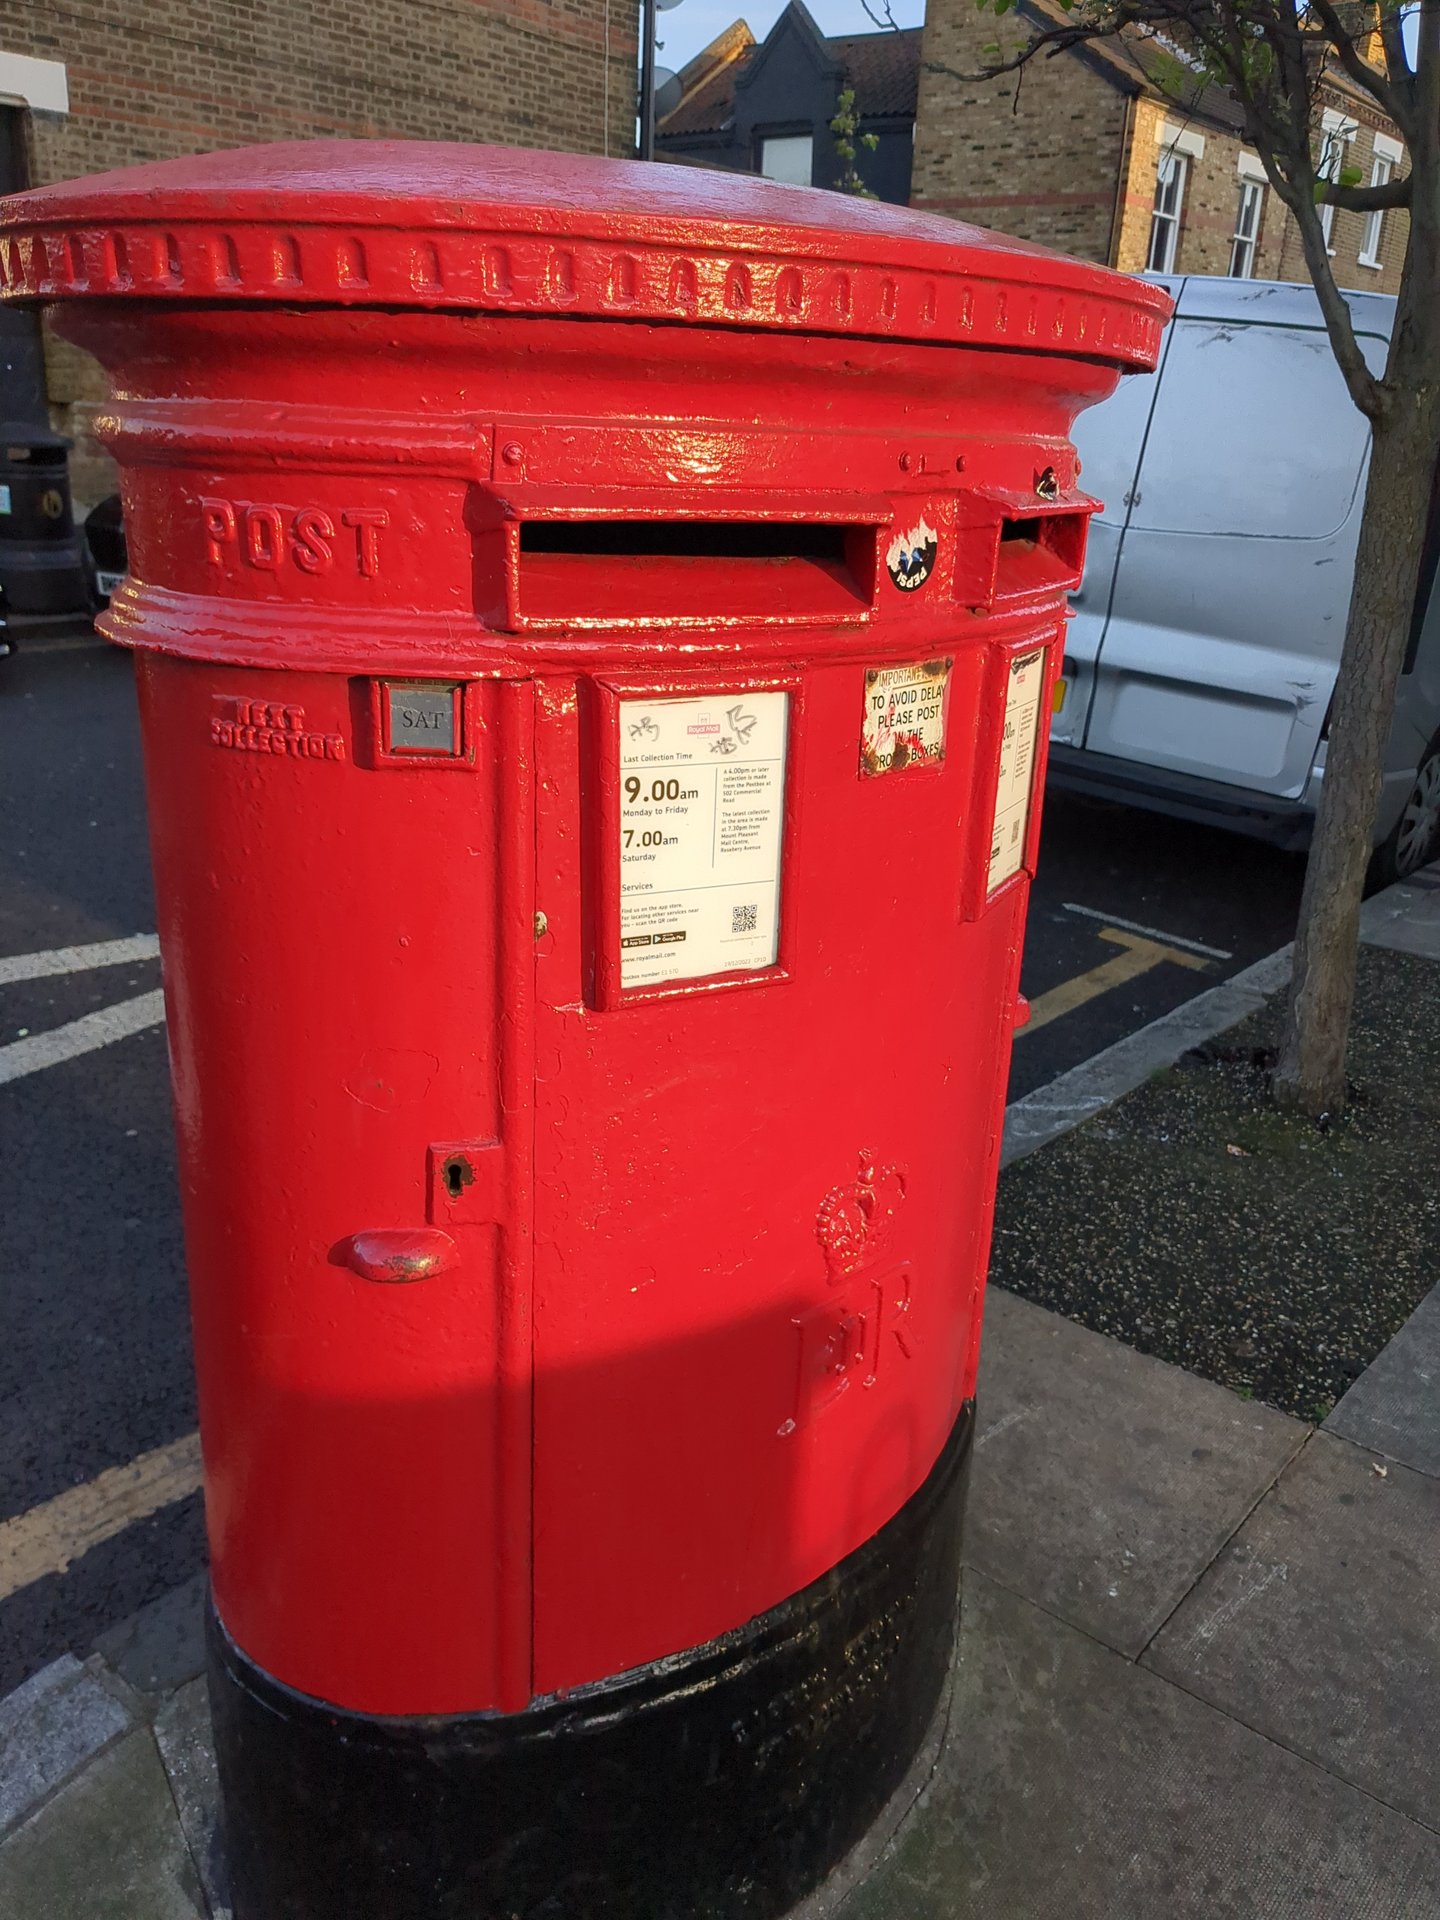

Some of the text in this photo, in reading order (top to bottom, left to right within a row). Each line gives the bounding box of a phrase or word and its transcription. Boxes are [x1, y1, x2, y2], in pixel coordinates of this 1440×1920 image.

[200, 497, 390, 579] POST
[896, 566, 928, 589] PEPSI
[872, 684, 946, 710] TO AVOID DELAY
[235, 696, 305, 731] NEXT
[402, 710, 444, 730] SAT
[878, 705, 940, 729] PLEASE POST
[210, 717, 346, 761] COLLECTION
[907, 727, 924, 740] THE
[641, 753, 674, 762] Collection
[624, 776, 698, 803] 9.00am
[623, 808, 652, 817] Monday
[665, 806, 688, 814] Friday
[623, 830, 678, 848] 7.00am
[622, 853, 656, 862] Saturday
[622, 882, 653, 892] Services
